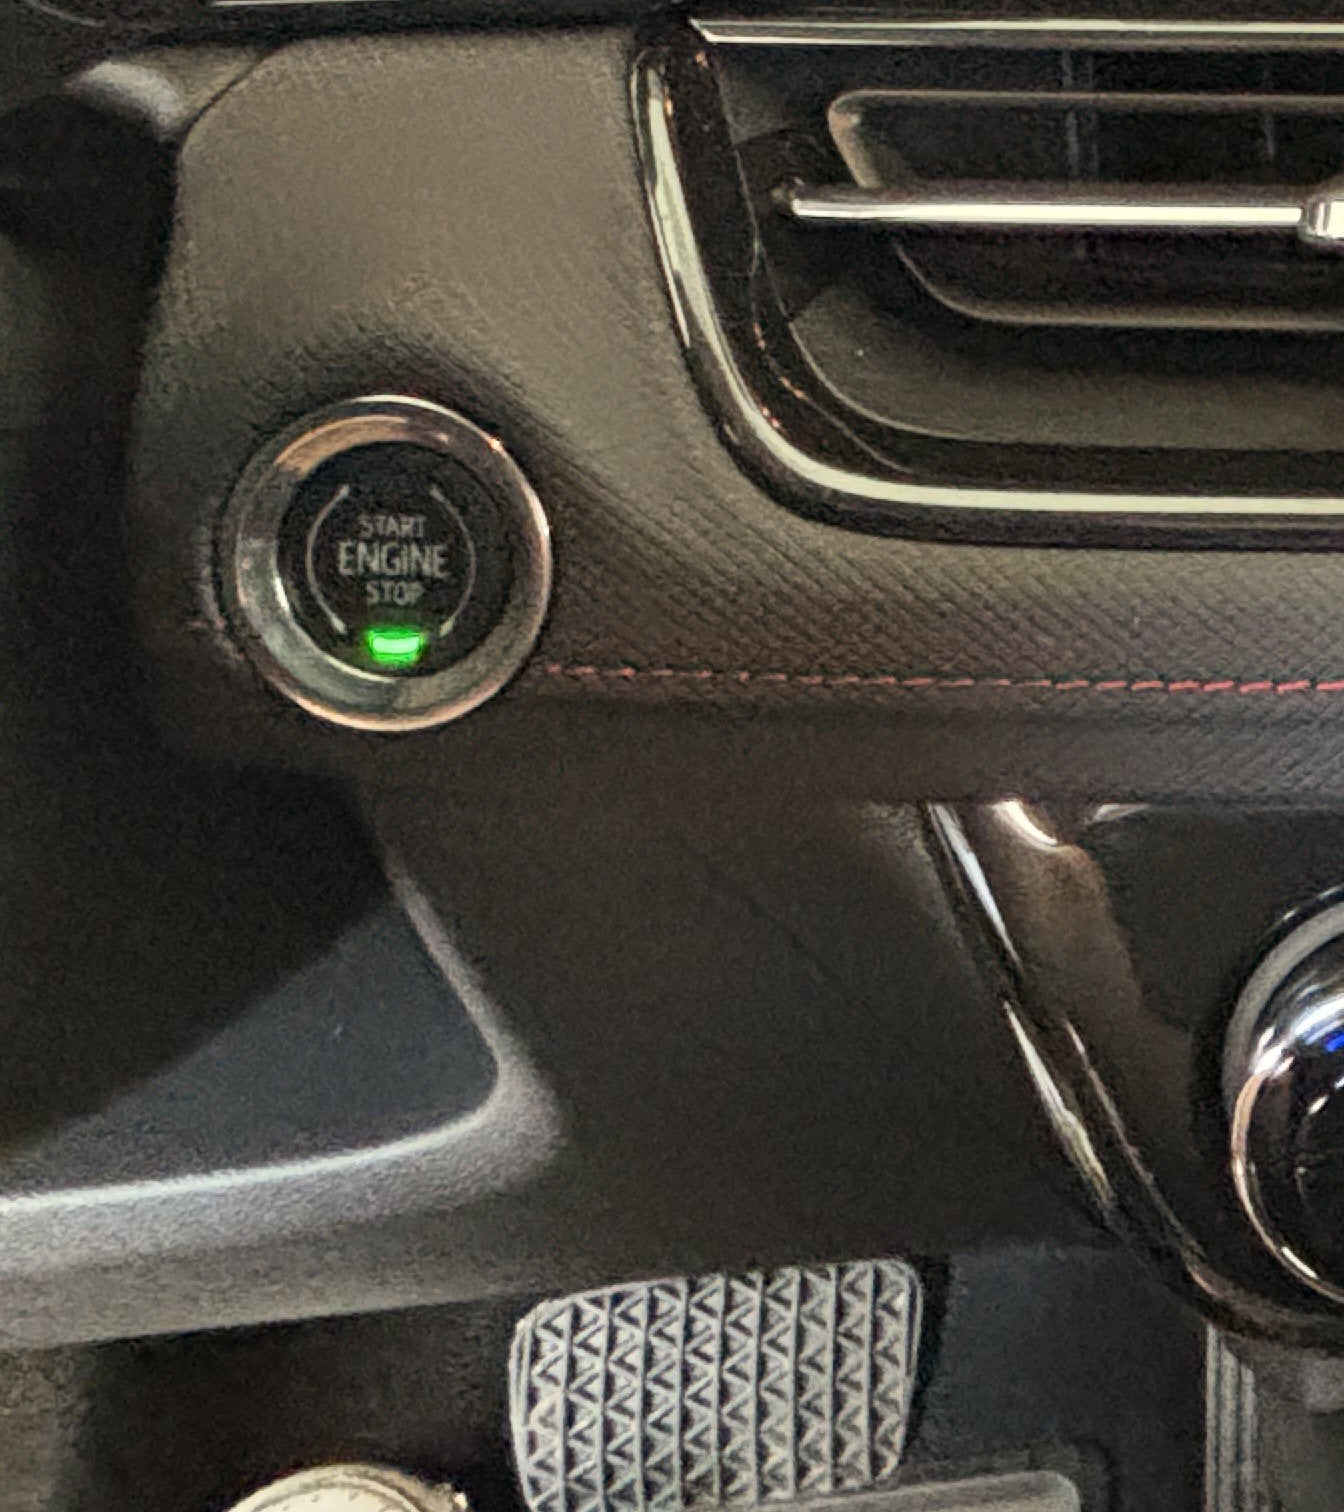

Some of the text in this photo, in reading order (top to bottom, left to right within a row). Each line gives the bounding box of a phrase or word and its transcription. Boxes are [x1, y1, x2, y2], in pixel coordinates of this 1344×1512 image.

[358, 513, 427, 538] START
[338, 541, 449, 578] ENGINE
[365, 582, 426, 605] STOP
